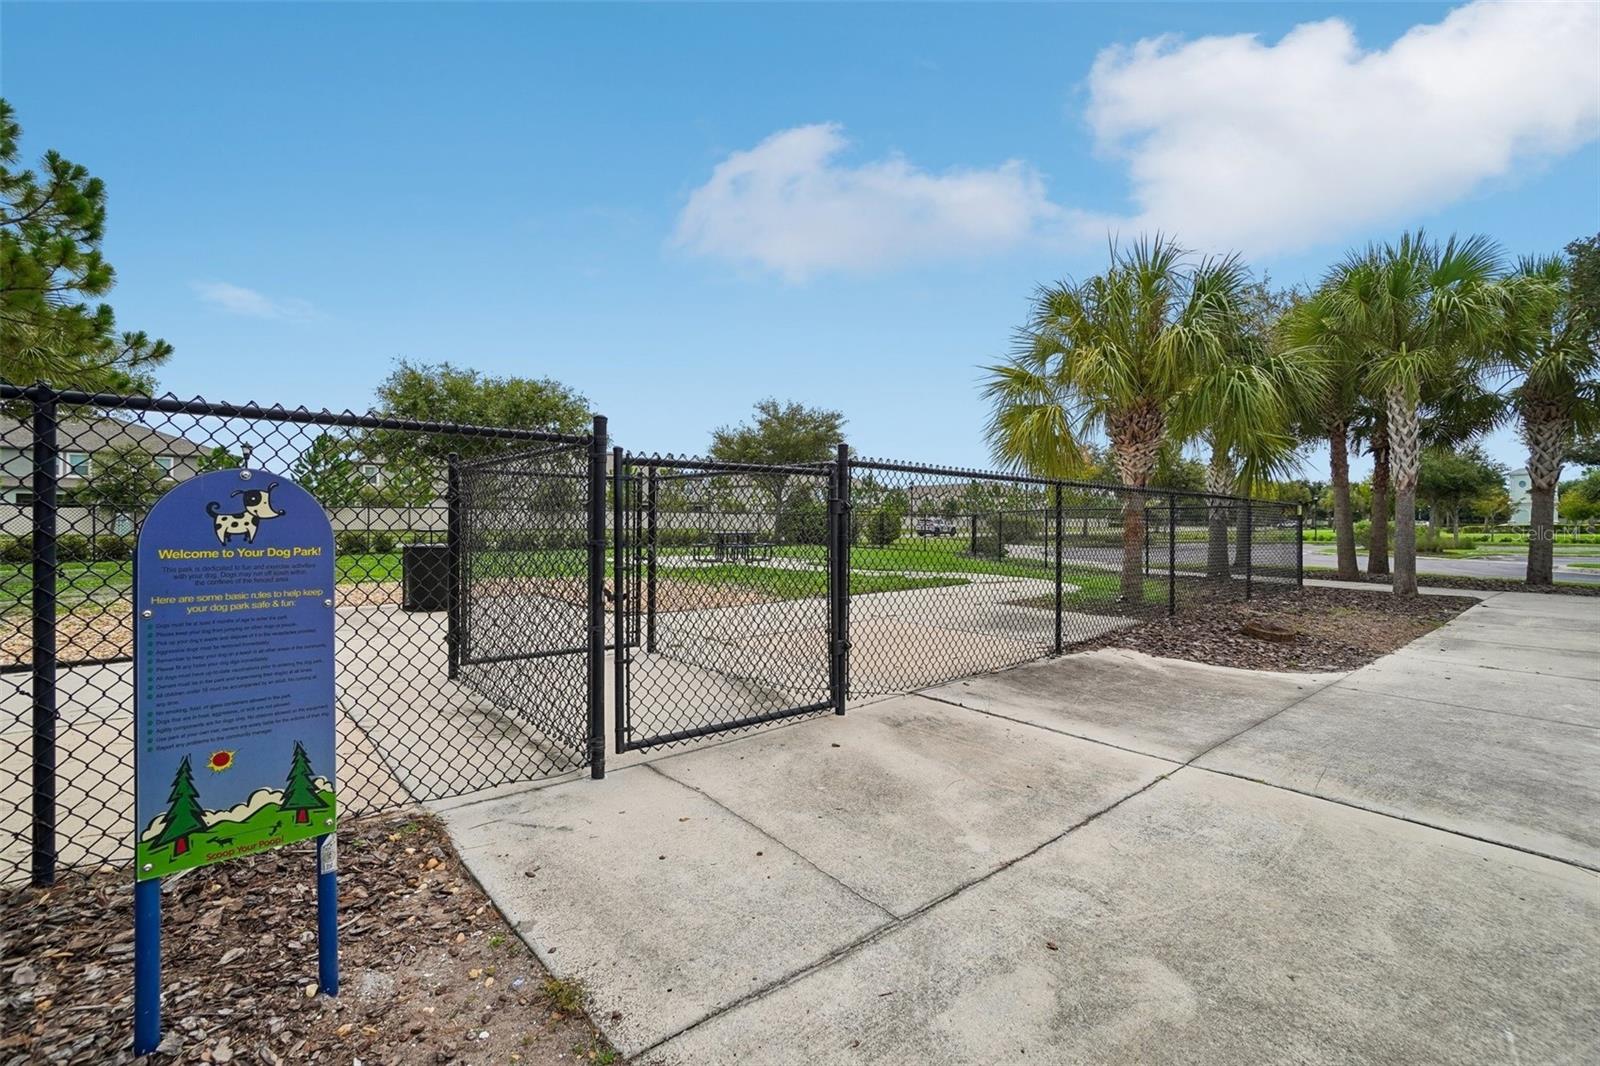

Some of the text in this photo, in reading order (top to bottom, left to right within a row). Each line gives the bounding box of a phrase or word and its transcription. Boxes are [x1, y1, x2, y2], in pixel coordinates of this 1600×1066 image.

[158, 546, 321, 560] Welcome to Your Dog Park!
[151, 596, 176, 605] Here
[225, 592, 249, 602] basic
[251, 591, 272, 600] rules
[284, 590, 302, 600] help
[304, 588, 324, 599] keep
[187, 606, 208, 615] your
[209, 604, 228, 612] dog
[230, 602, 250, 612] park
[252, 601, 271, 610] safe
[206, 836, 284, 861] Scoop Your Poop!
